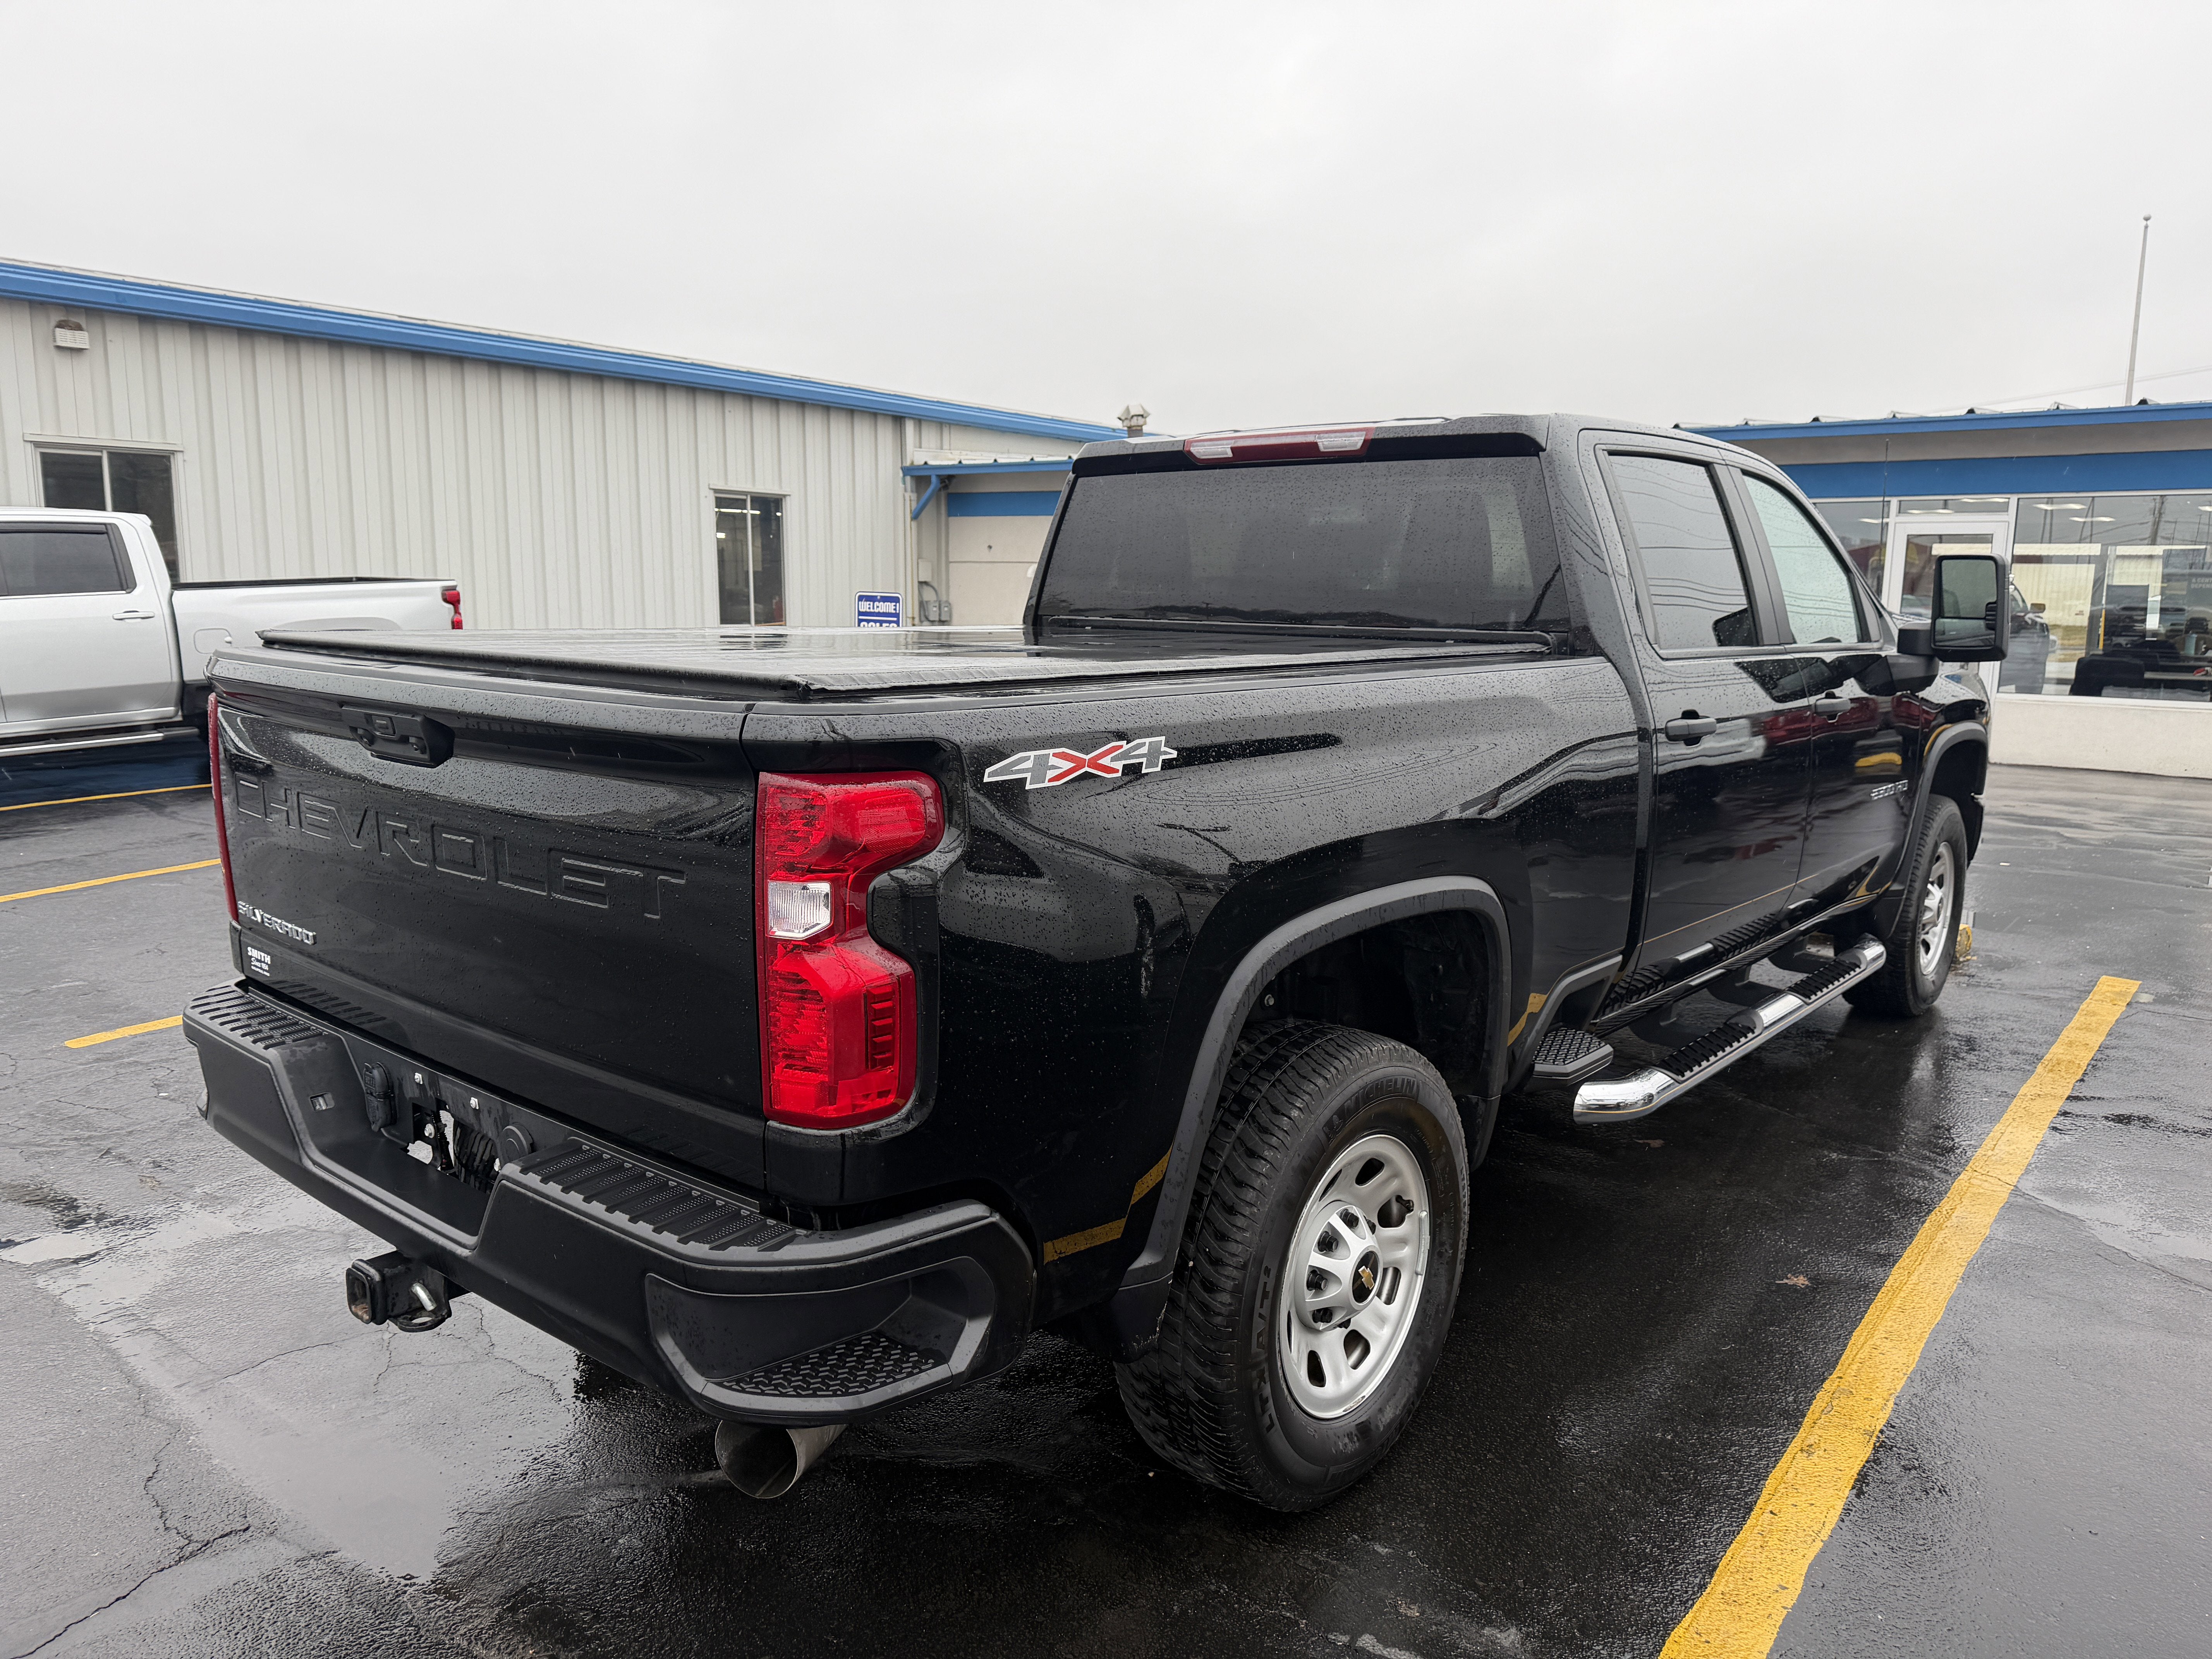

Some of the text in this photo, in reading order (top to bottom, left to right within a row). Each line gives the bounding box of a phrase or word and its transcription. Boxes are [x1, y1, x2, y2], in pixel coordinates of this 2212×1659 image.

[858, 601, 899, 613] WELCOME!
[235, 771, 688, 920] CHEVROLET
[237, 900, 317, 945] SILVERADO
[247, 946, 271, 964] SMITH
[1344, 1077, 1417, 1116] MICHELIN
